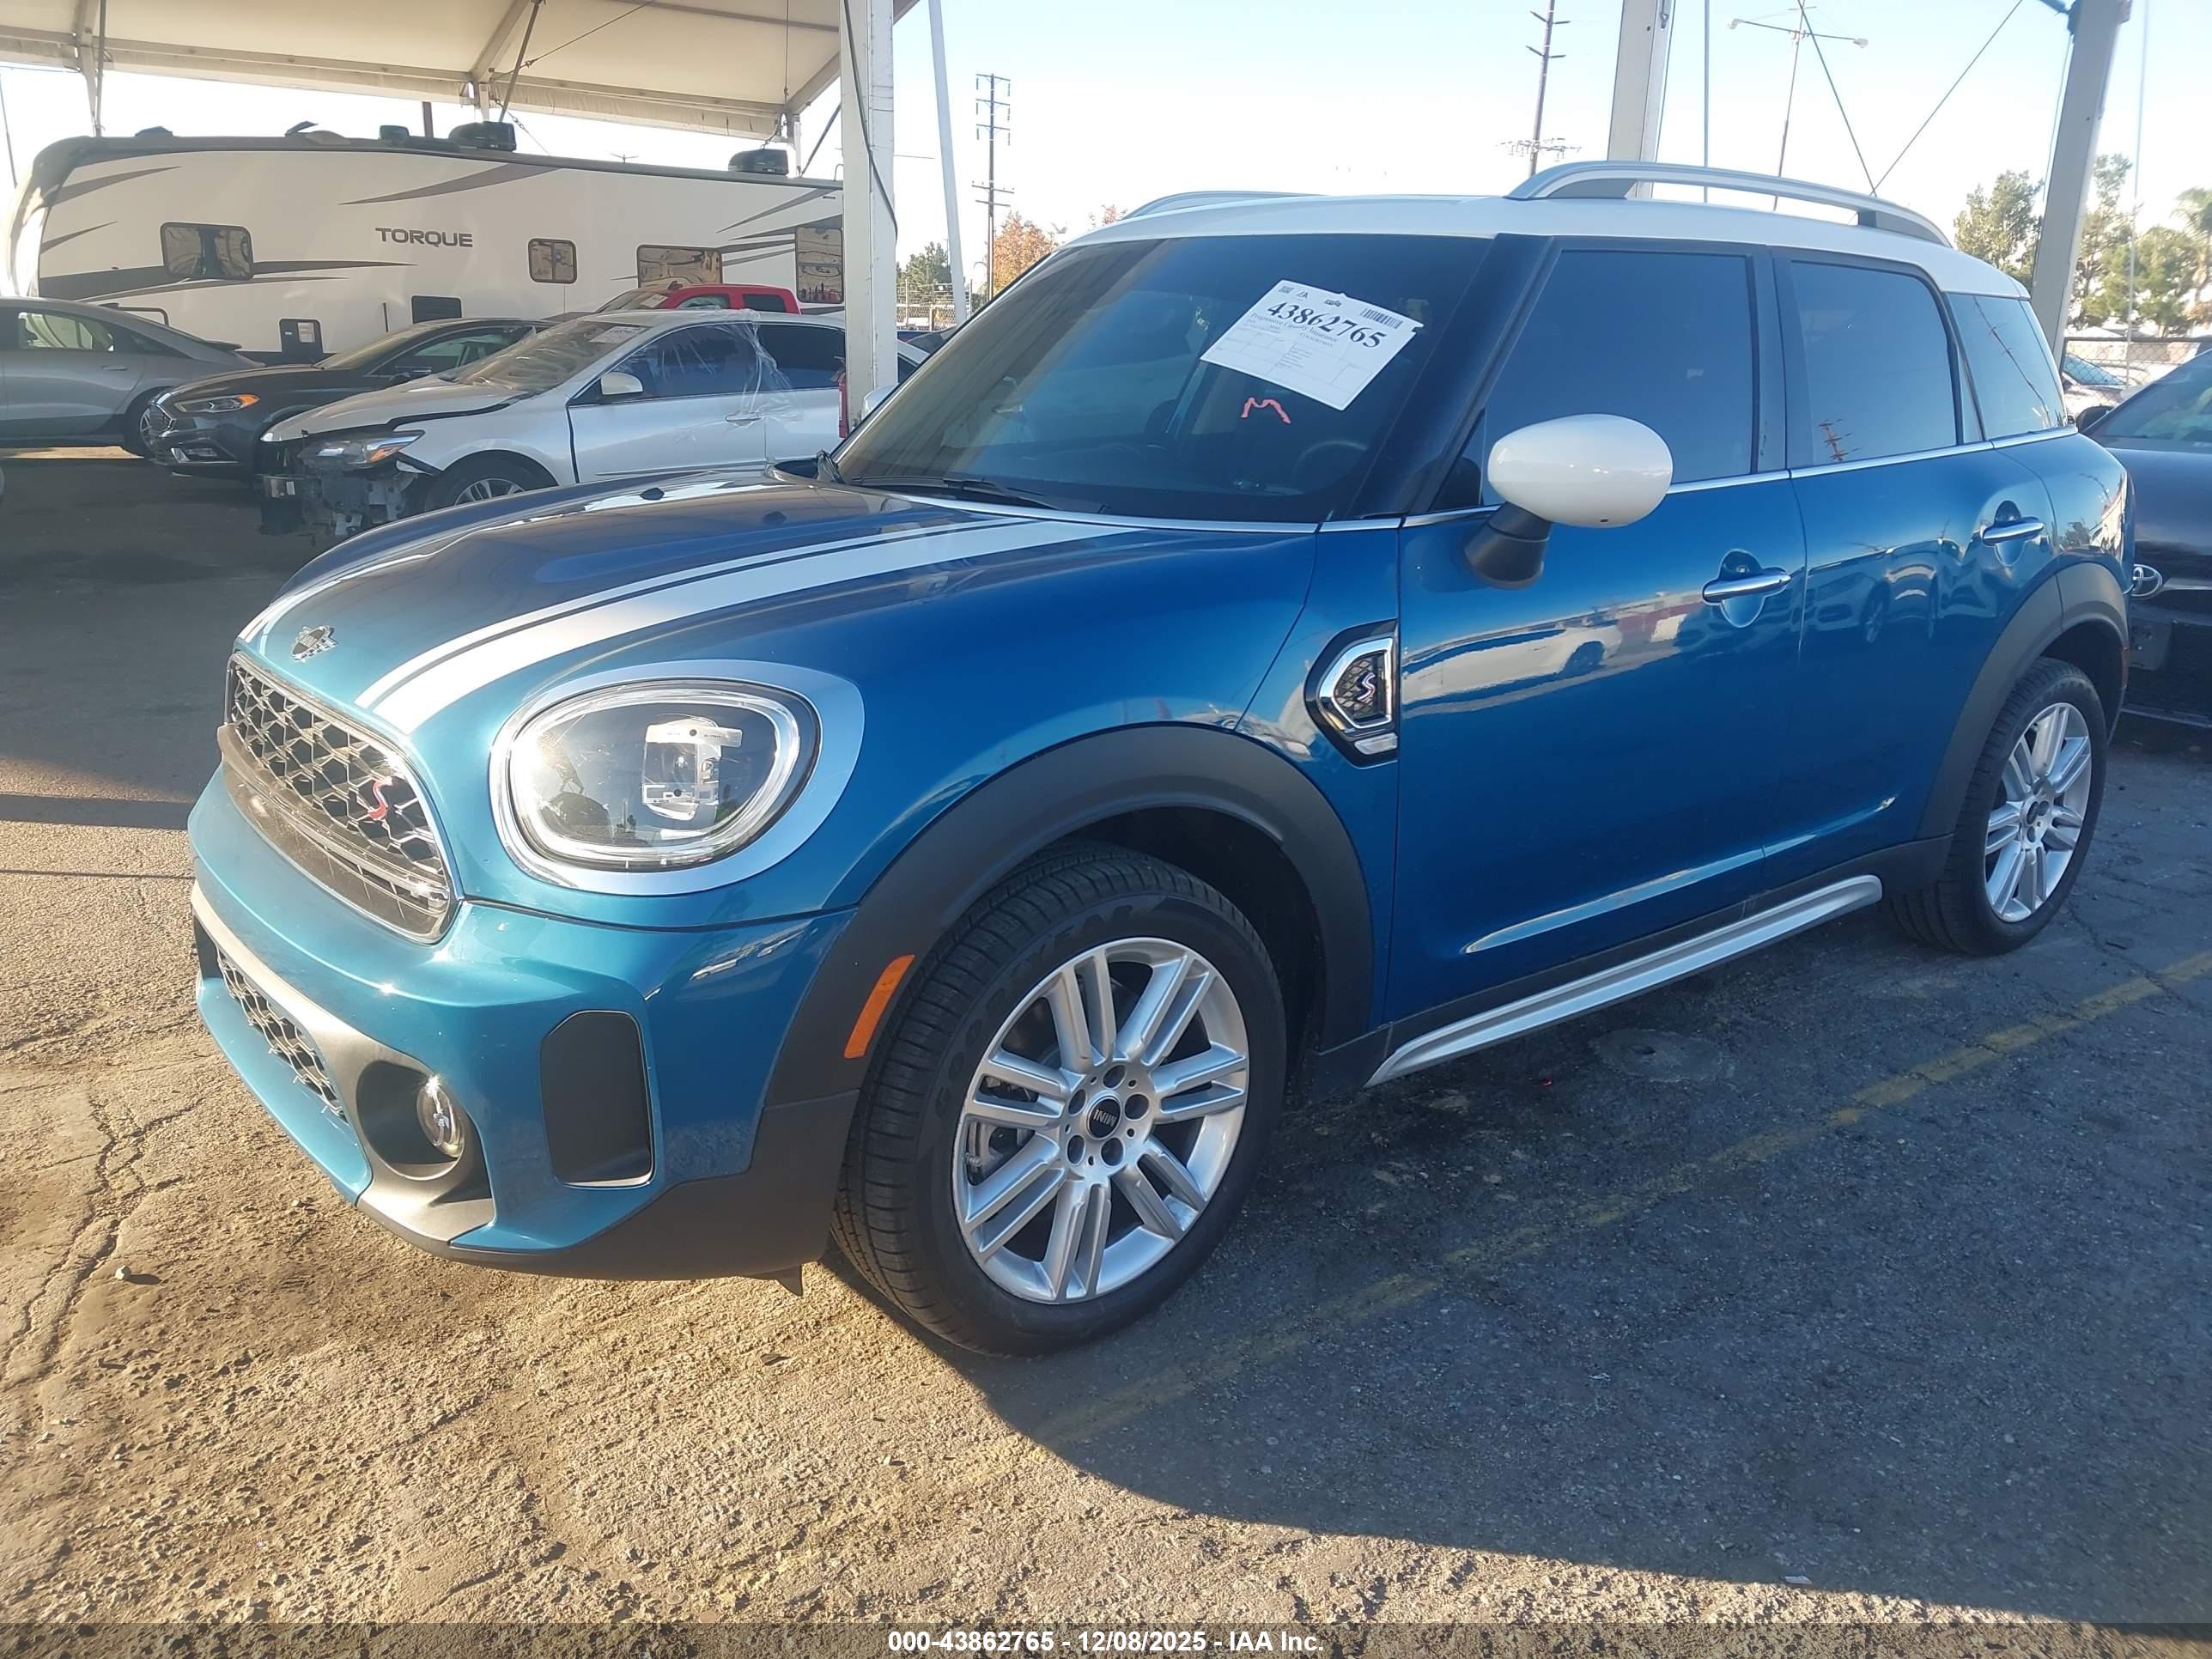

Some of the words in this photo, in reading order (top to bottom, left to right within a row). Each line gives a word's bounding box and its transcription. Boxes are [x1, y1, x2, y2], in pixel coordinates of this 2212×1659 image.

[374, 227, 473, 247] TORQUE
[1267, 301, 1388, 349] 43862765
[1092, 1108, 1119, 1128] MINI
